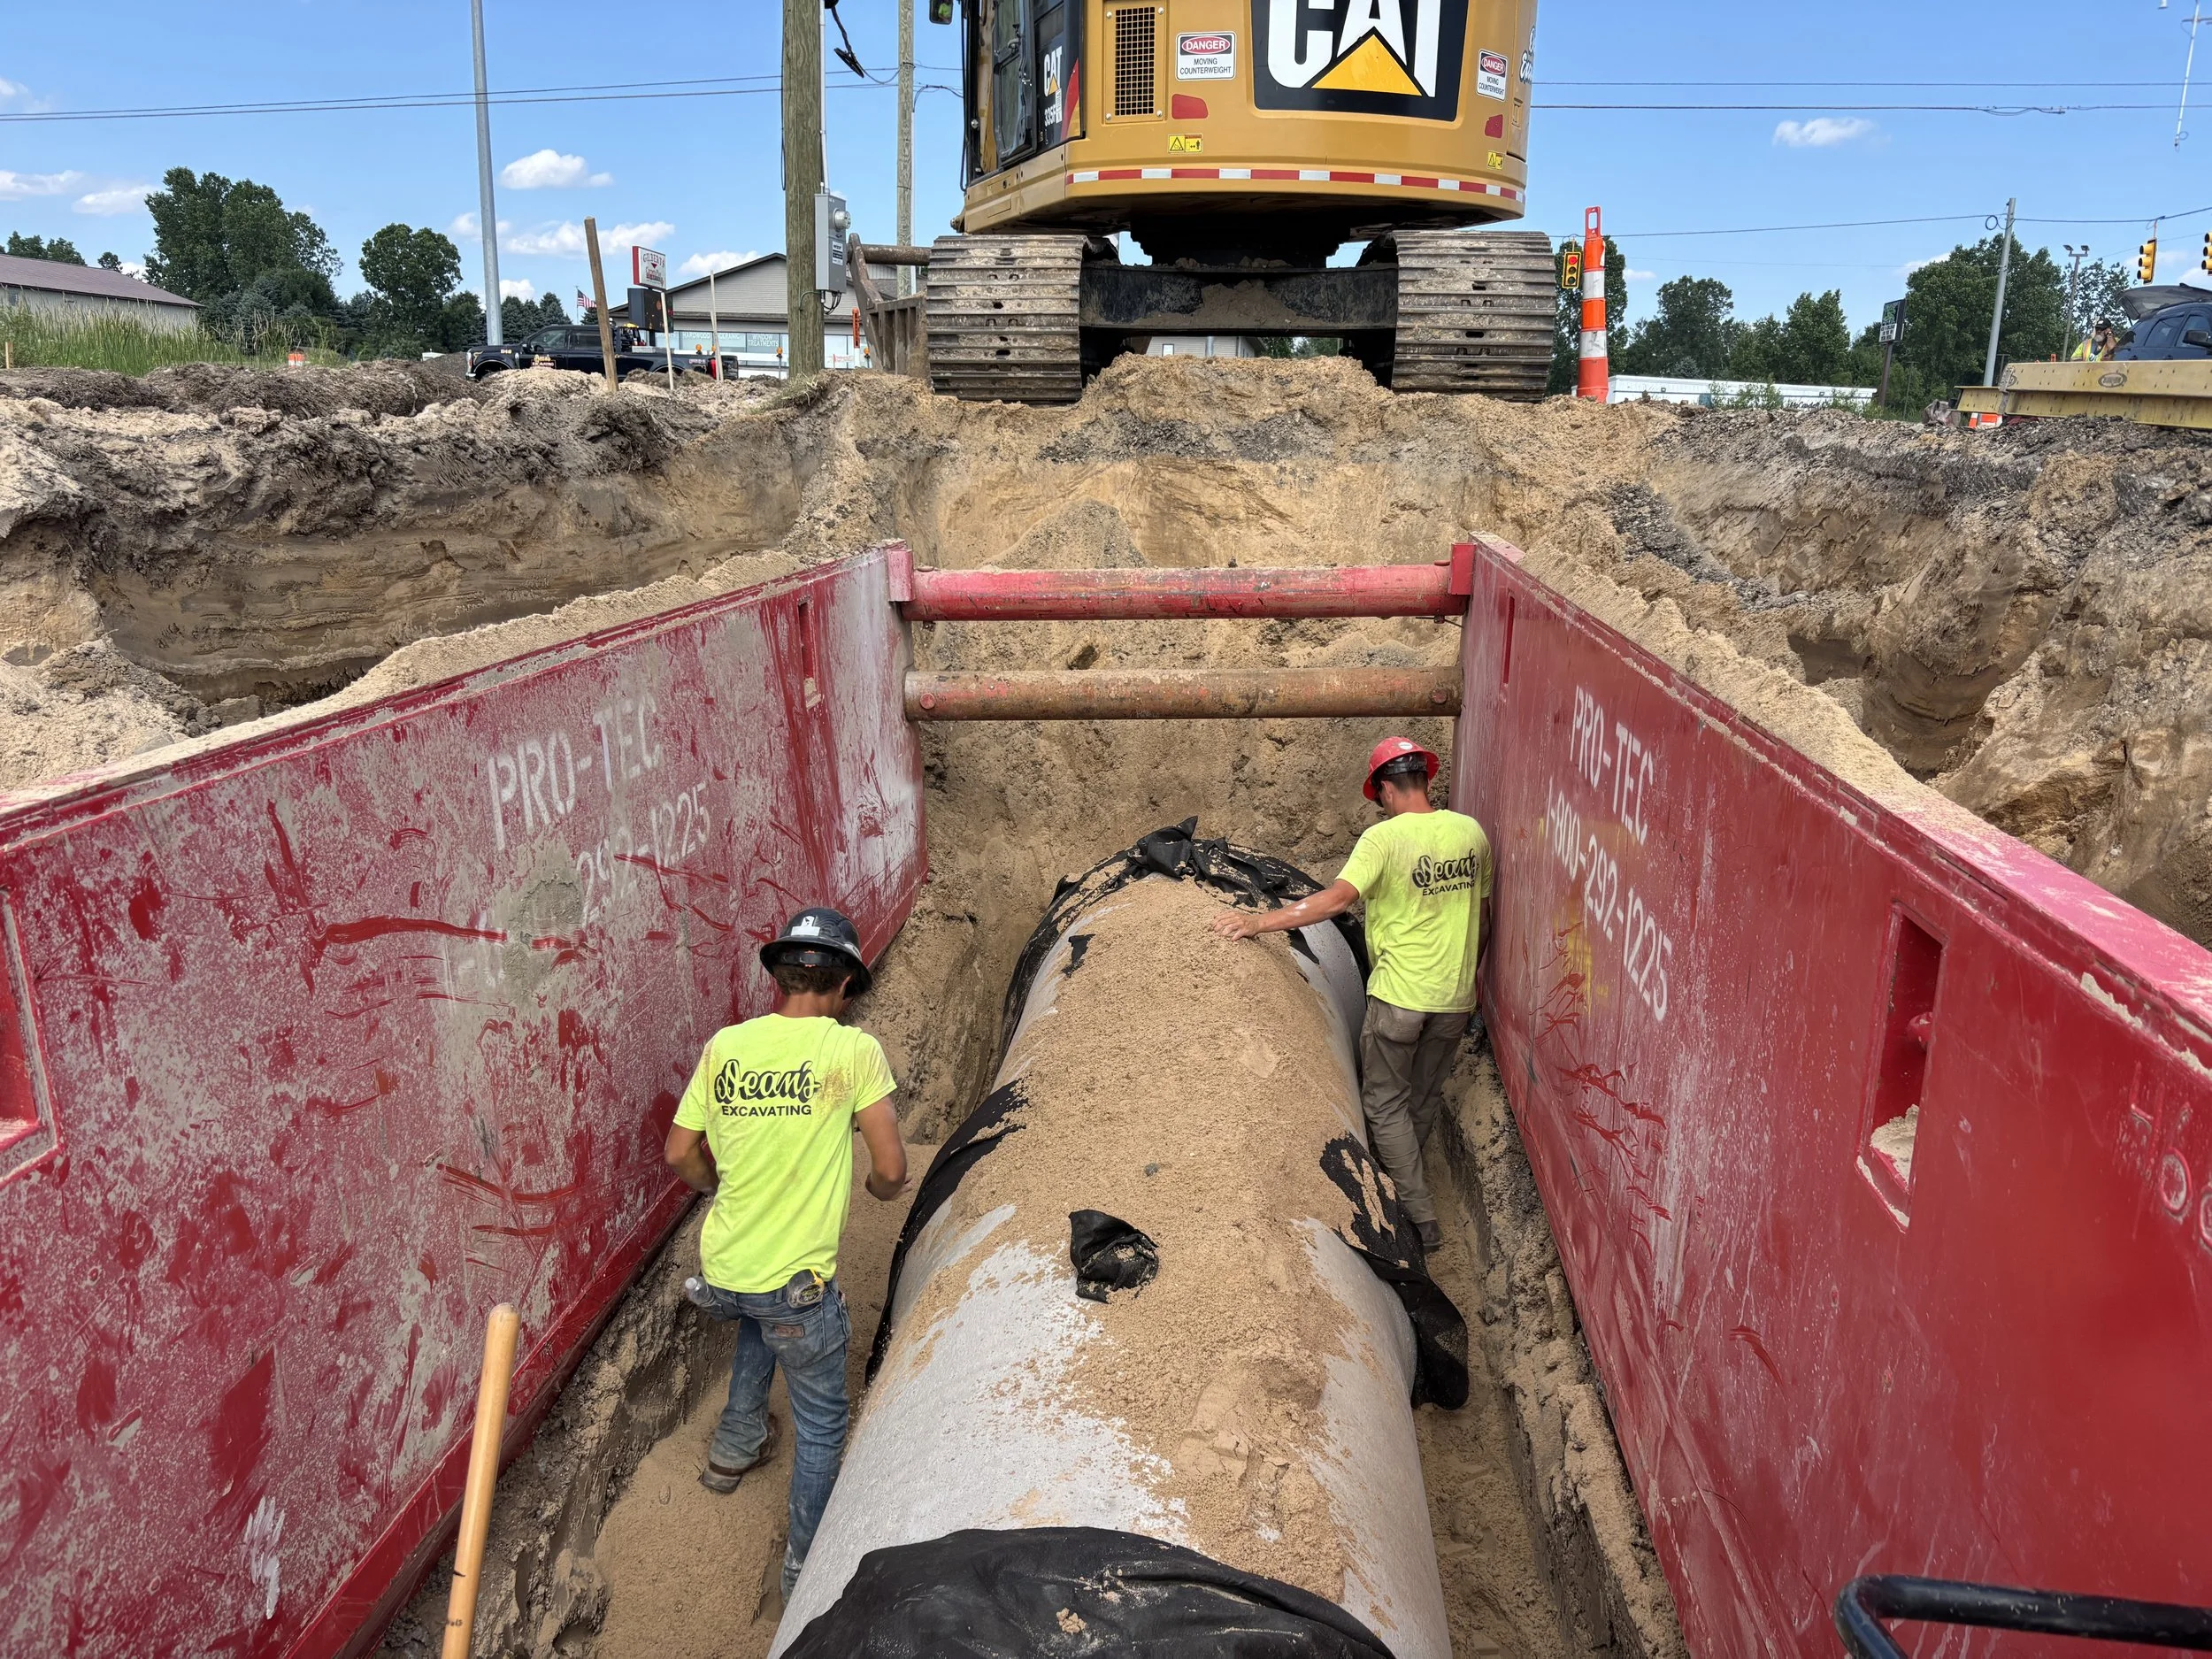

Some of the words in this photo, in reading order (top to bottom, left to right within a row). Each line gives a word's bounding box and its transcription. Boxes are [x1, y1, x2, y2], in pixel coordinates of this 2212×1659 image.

[1186, 40, 1226, 50] DANGER
[1044, 45, 1062, 96] CAT
[1483, 58, 1504, 72] DANGER
[488, 694, 662, 851] PRO-TEC
[1570, 685, 1654, 846] PRO-TEC
[1422, 879, 1476, 896] EXCAVATING
[1545, 776, 1672, 1022] 1-800-292-1225
[722, 1104, 812, 1117] EXCAVATING
